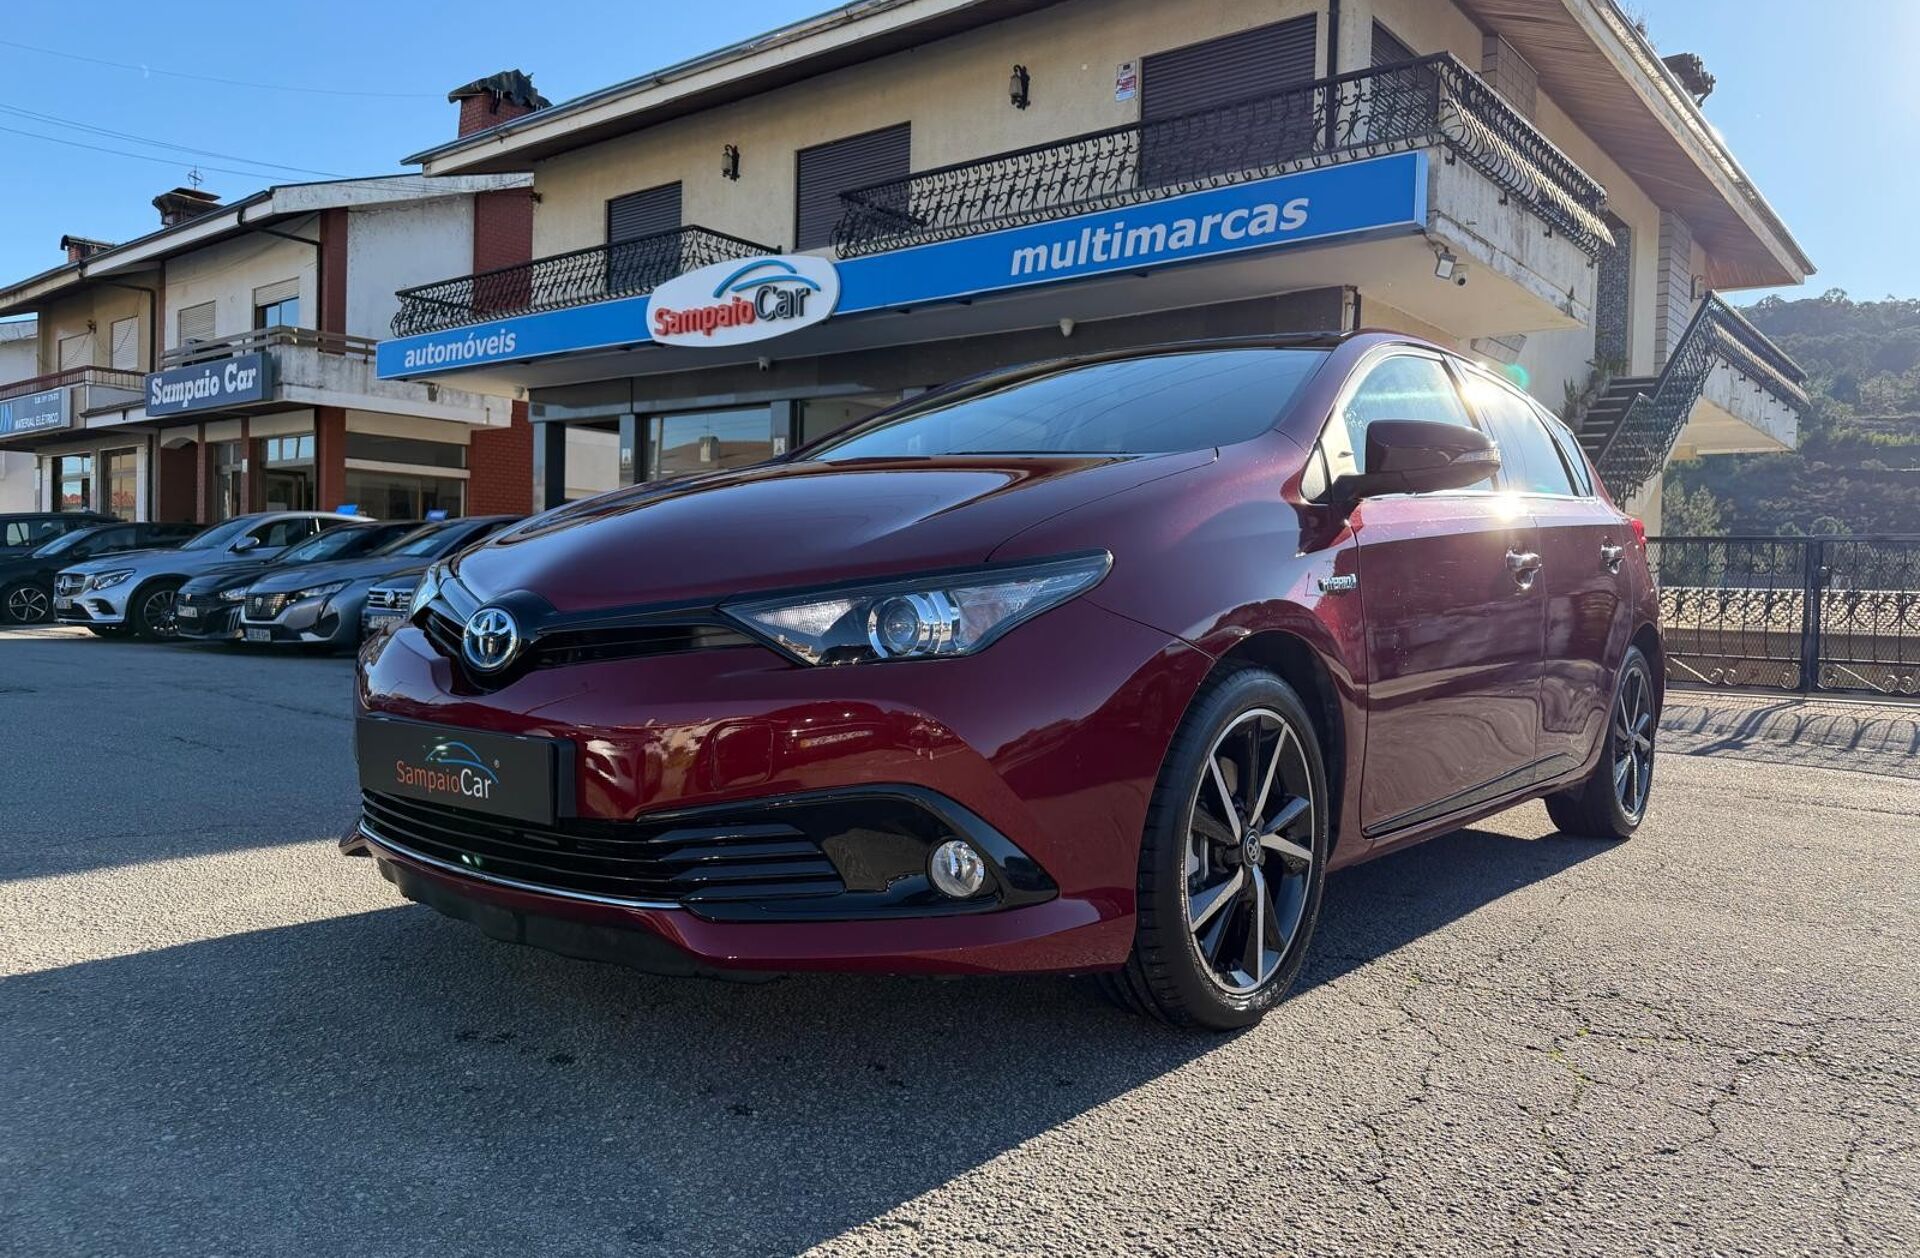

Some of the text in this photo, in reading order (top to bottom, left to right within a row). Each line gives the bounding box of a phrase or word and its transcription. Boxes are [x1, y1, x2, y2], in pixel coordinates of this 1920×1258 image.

[1010, 197, 1310, 276] multimarcas
[655, 285, 811, 336] SampaioCar
[404, 328, 517, 368] automóveis
[151, 362, 256, 408] Sampaio Car
[396, 760, 492, 799] SampaioCar
